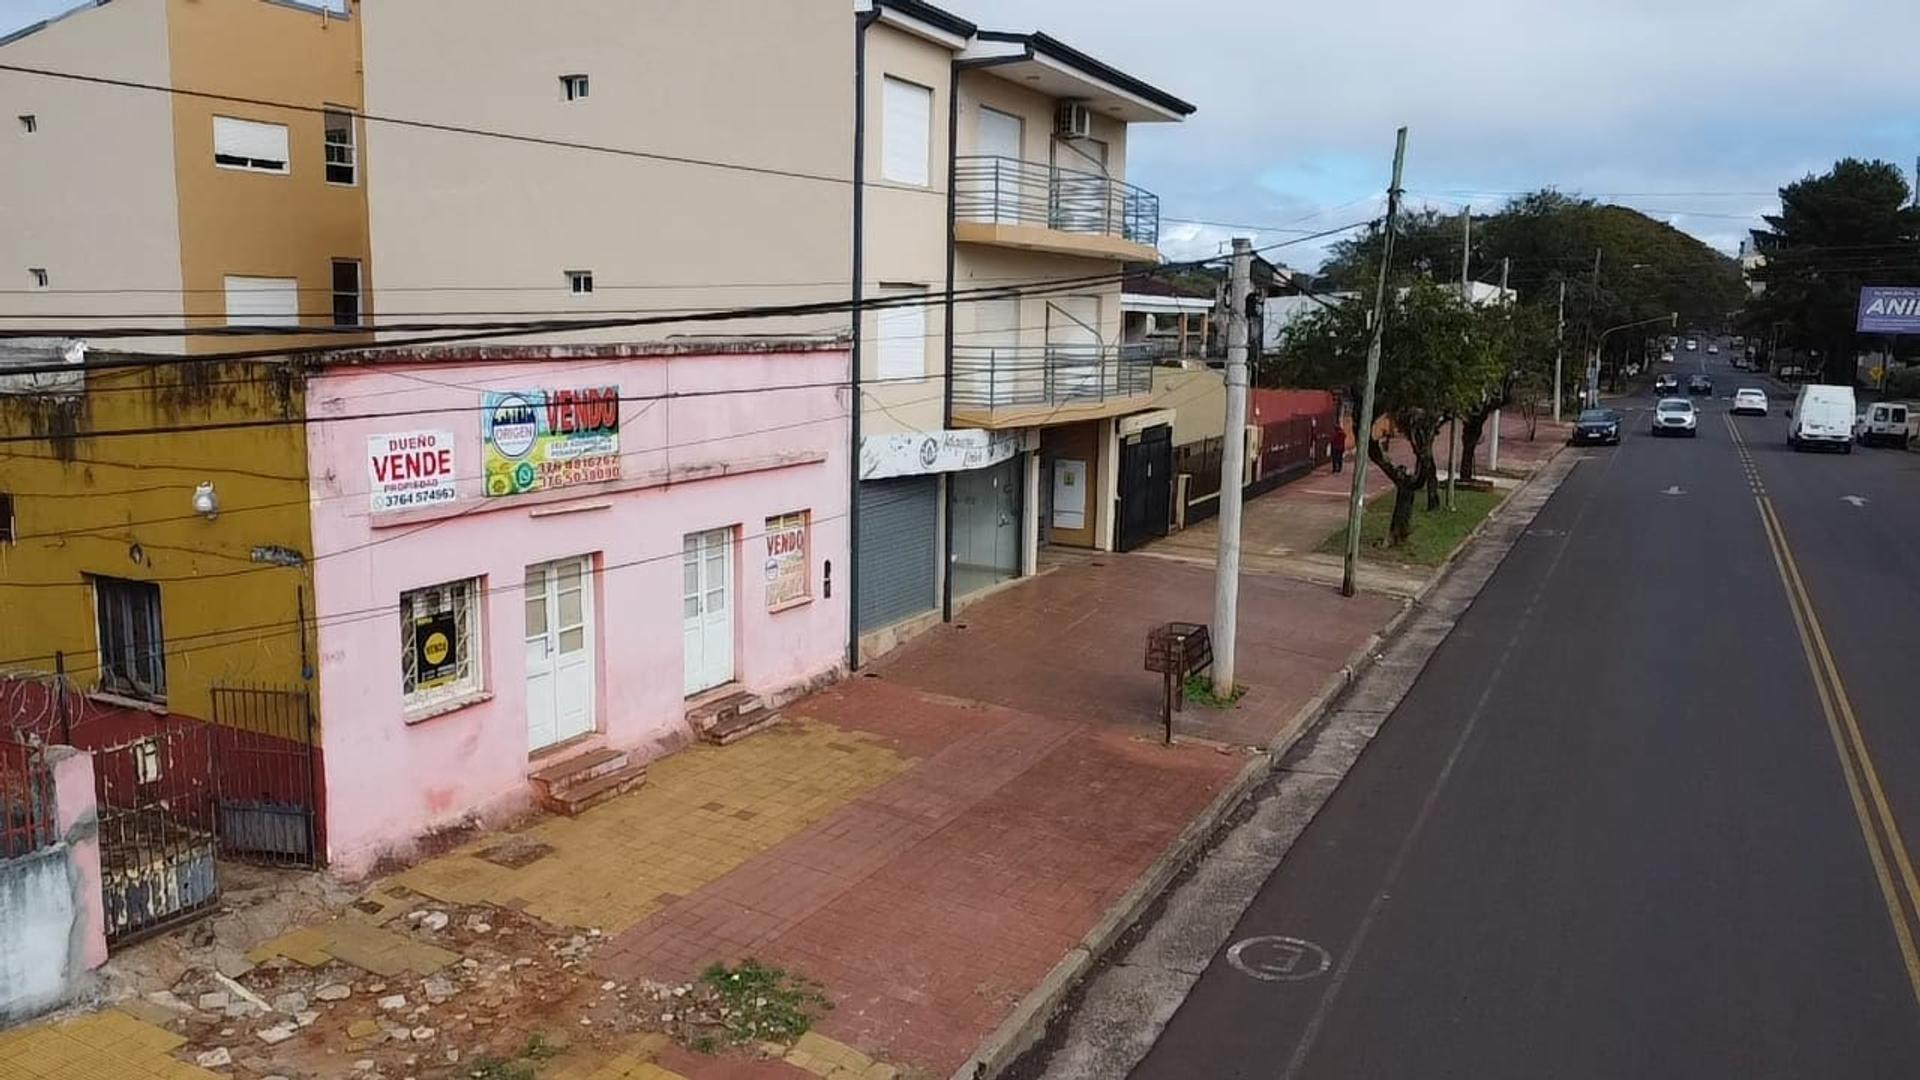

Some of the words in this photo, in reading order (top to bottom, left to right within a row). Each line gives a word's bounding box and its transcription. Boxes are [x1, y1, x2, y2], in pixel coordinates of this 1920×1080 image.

[544, 386, 617, 435] VENDO
[496, 426, 533, 441] ORIGEN
[388, 435, 436, 452] DUEÑO
[372, 449, 451, 482] VENDE
[383, 479, 439, 493] PROPIEDAD
[385, 493, 413, 507] 3764
[766, 530, 804, 557] VENDO
